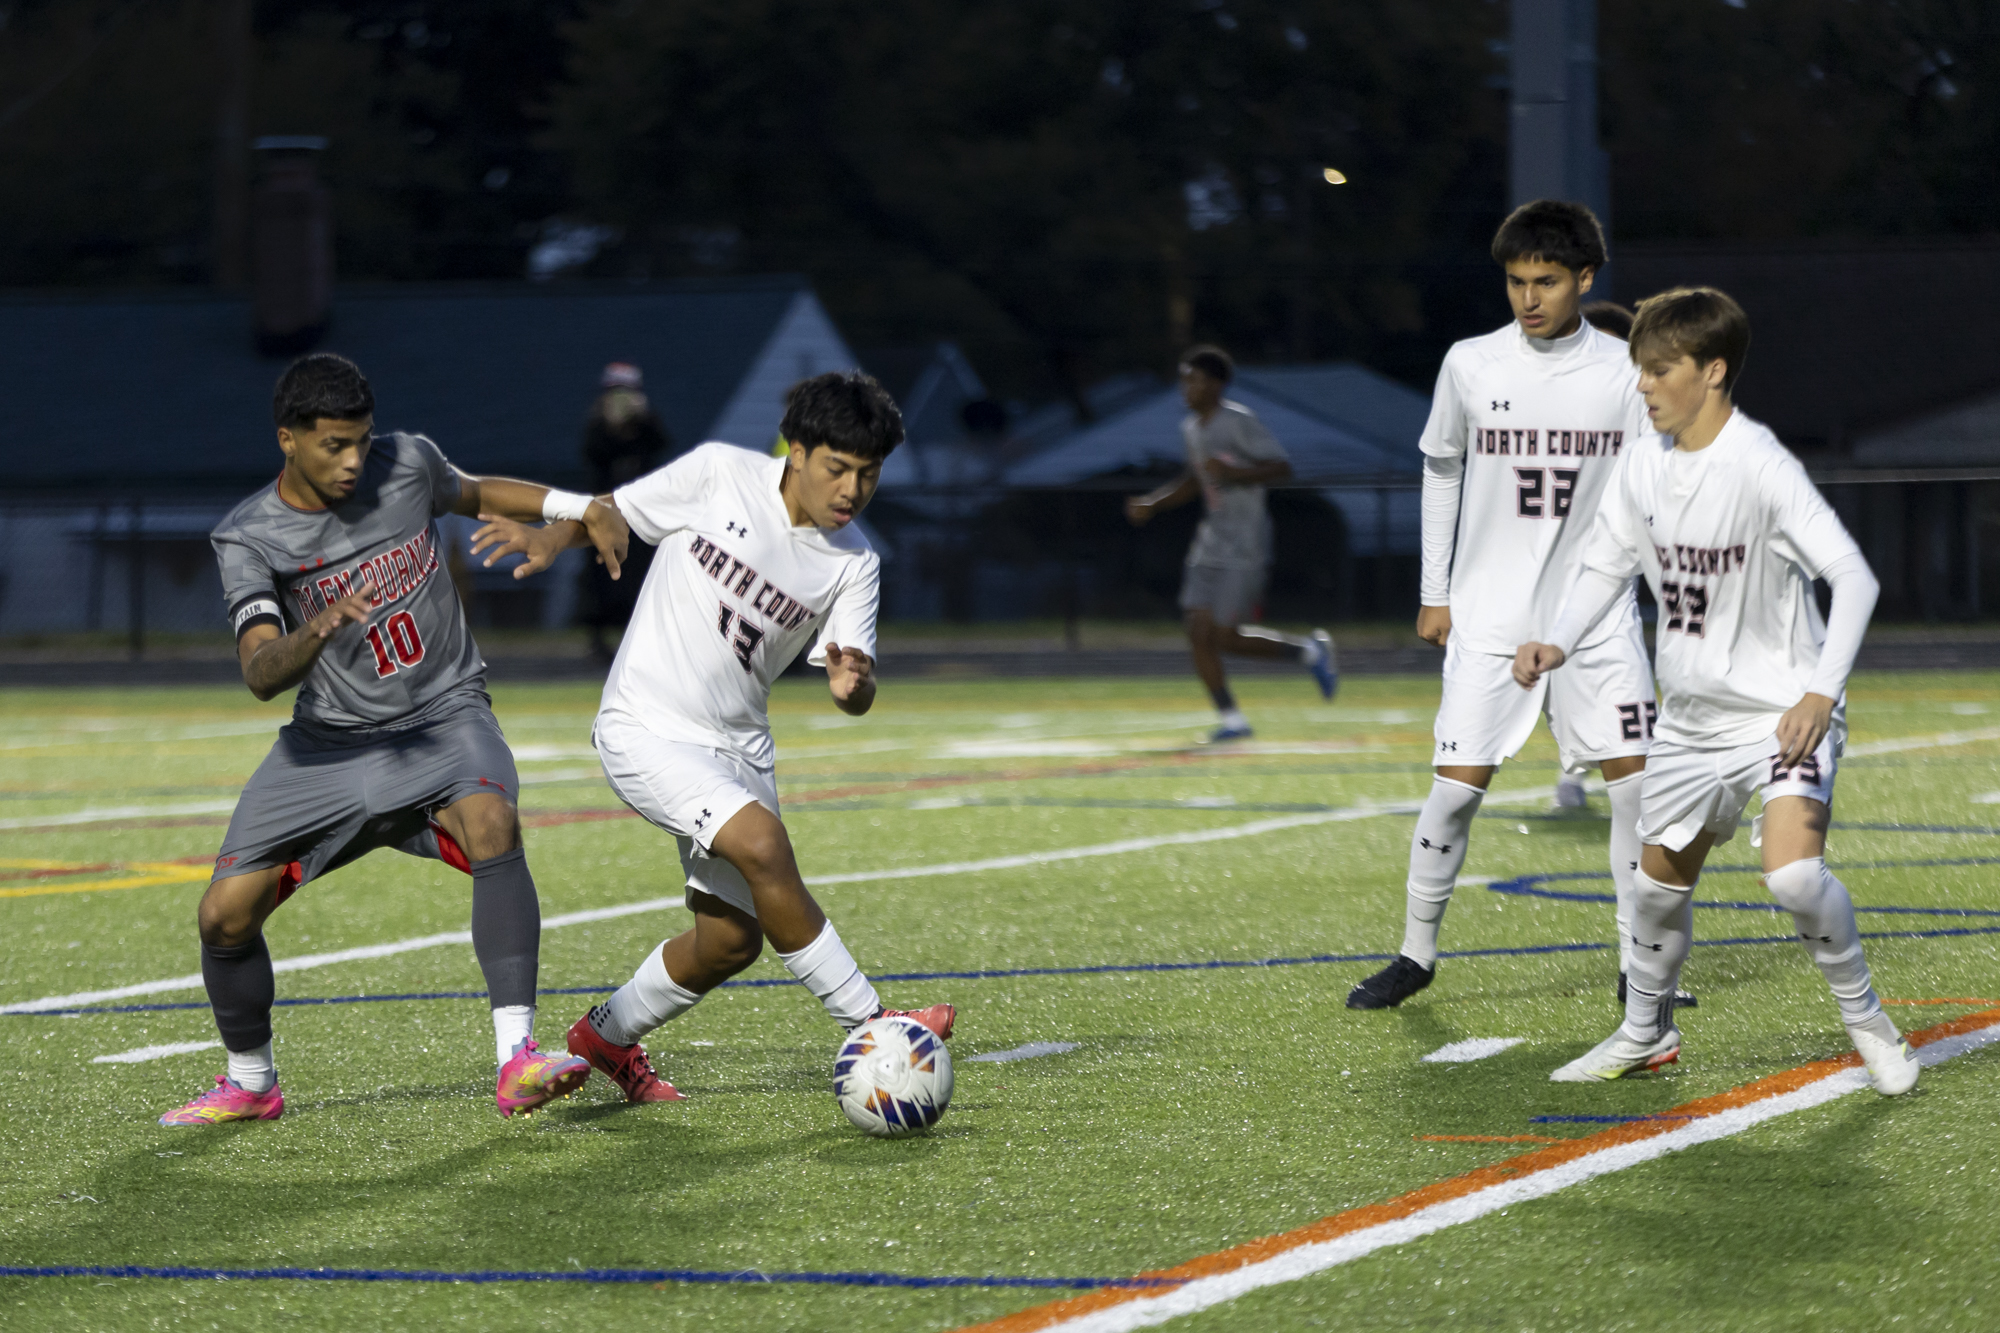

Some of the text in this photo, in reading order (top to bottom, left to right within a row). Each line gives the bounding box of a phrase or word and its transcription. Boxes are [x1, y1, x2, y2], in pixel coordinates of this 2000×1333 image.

[1475, 427, 1625, 457] NORTH COUNTY
[1512, 466, 1581, 519] 22
[688, 534, 817, 632] NORTH COUN
[237, 603, 262, 625] TAIN
[364, 609, 426, 679] 10
[717, 600, 765, 675] 13
